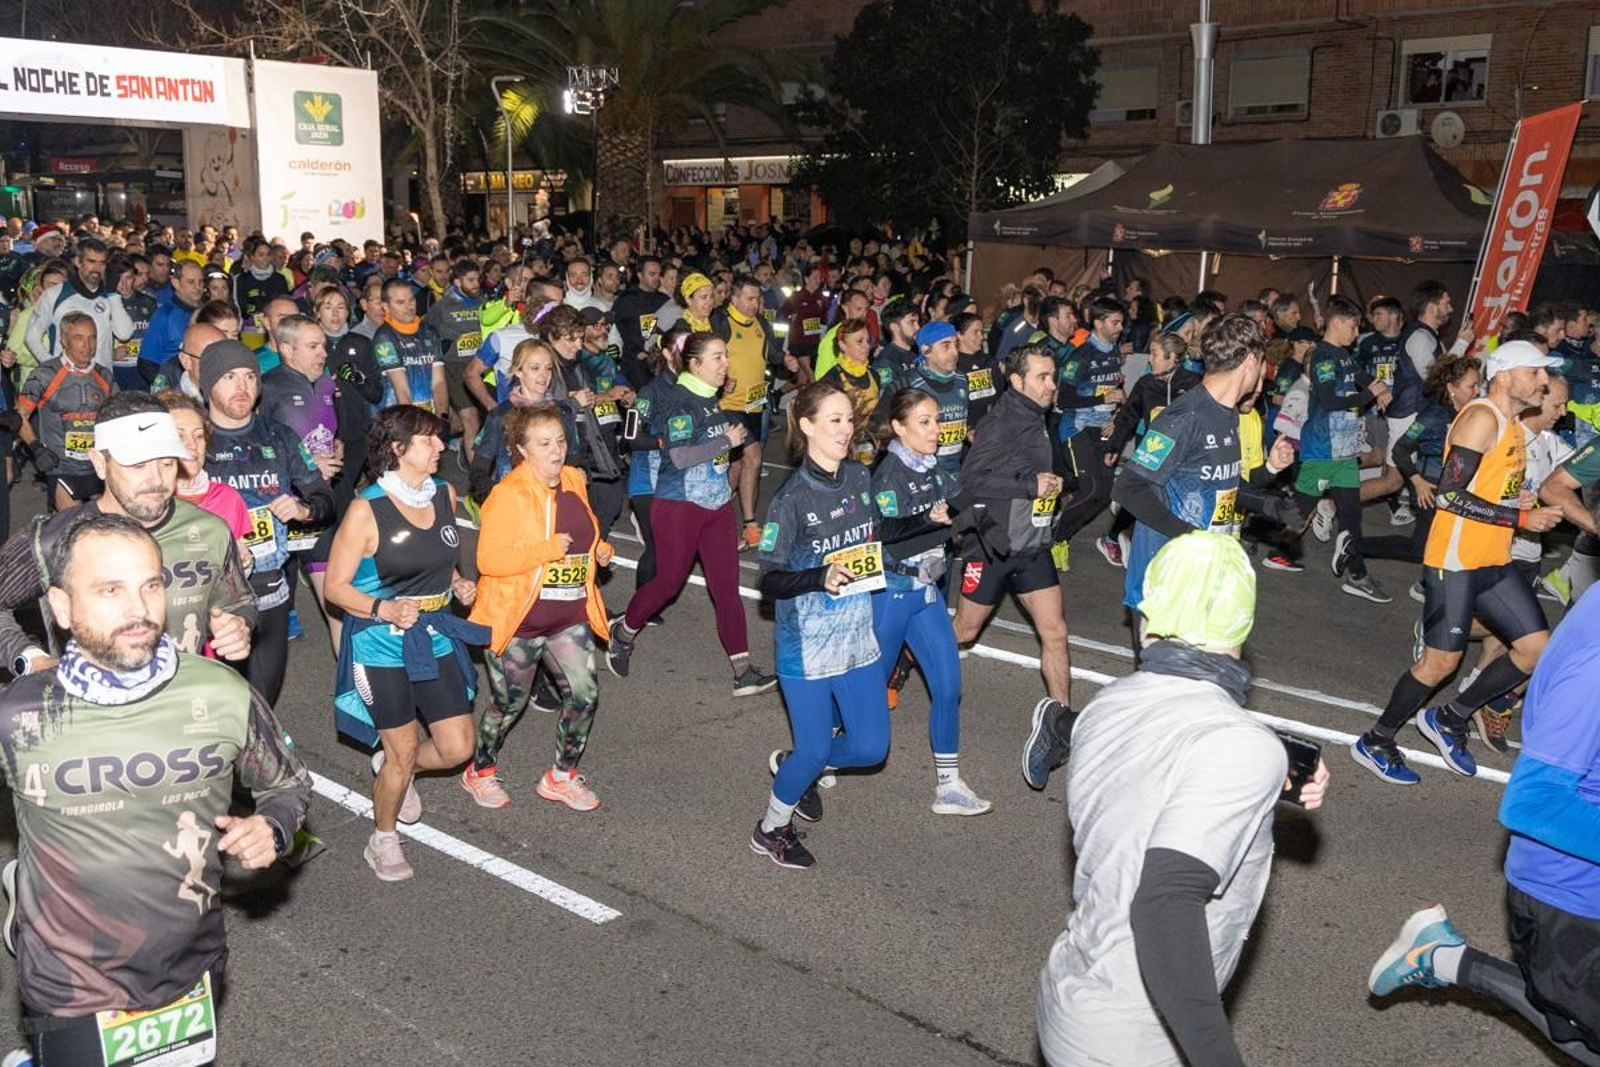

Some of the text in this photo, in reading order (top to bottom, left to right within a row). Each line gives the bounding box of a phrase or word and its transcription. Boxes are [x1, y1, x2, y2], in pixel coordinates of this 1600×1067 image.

[13, 66, 81, 95] NOCHE
[85, 72, 111, 97] DE
[115, 75, 153, 99] SAN
[288, 158, 352, 172] calderón
[665, 163, 740, 184] CONFECCIONS
[1482, 145, 1550, 332] derón
[1200, 463, 1231, 481] SAN
[812, 533, 841, 555] SAN
[548, 566, 588, 584] 3528
[54, 743, 225, 796] CROSS
[60, 799, 125, 816] FUENGIROLA
[161, 793, 182, 805] LOS
[113, 1001, 206, 1062] 2672
